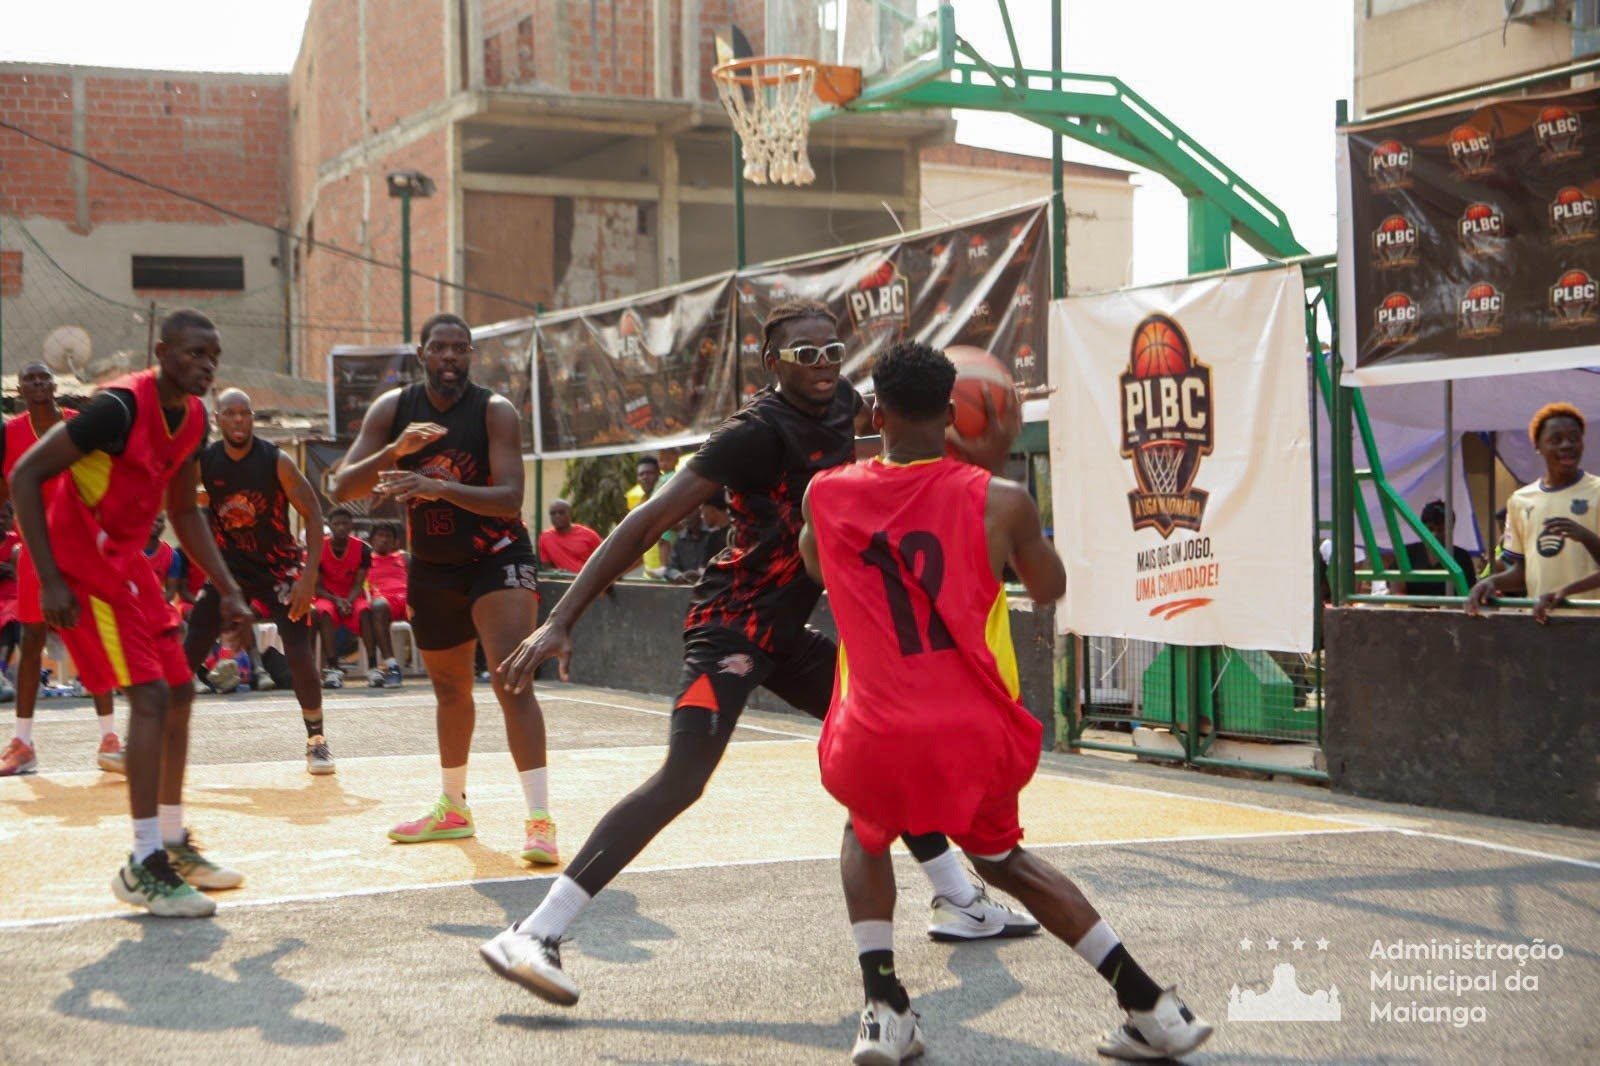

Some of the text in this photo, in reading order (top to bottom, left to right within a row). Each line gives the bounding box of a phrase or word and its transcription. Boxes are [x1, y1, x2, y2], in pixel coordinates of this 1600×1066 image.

[1538, 117, 1577, 138] PLBC
[1452, 136, 1489, 157] PLBC
[1373, 152, 1408, 169] PLBC
[1554, 200, 1593, 220] PLBC
[1463, 217, 1500, 235] PLBC
[1377, 229, 1415, 247] PLBC
[851, 285, 904, 321] PLBC
[1554, 284, 1594, 303] PLBC
[1379, 307, 1415, 323] PLBC
[1462, 297, 1500, 313] PLBC
[1125, 377, 1206, 433] PLBC
[424, 509, 455, 536] 15
[1137, 537, 1213, 572] MAIS QUE UM JOGO,
[503, 564, 537, 591] 15
[1136, 563, 1219, 602] UMA COMUNIDADE!
[858, 531, 958, 656] 12
